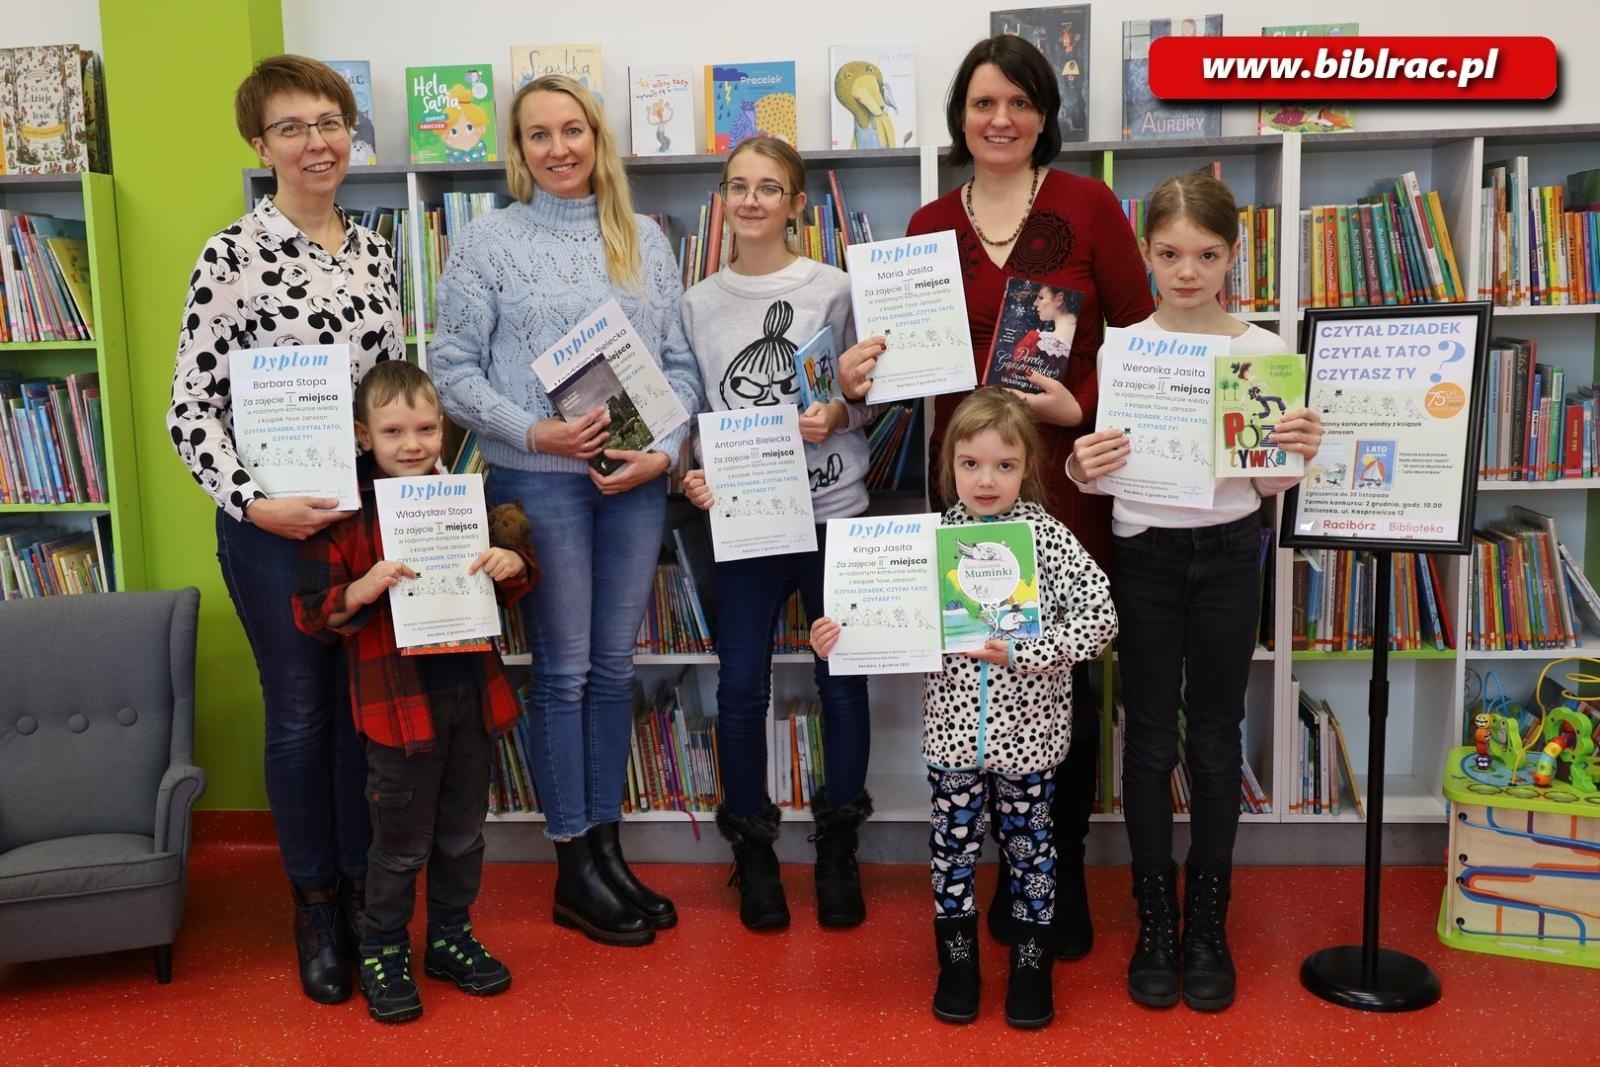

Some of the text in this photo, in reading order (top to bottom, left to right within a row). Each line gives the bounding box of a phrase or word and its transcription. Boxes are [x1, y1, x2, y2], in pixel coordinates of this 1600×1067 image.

[523, 50, 593, 80] Szpilka
[414, 72, 450, 97] Hela
[740, 75, 783, 85] Precelek
[423, 94, 461, 114] sama
[870, 242, 938, 263] Dyplom
[877, 265, 934, 280] Maria Jasita
[864, 288, 873, 297] Za
[876, 286, 902, 296] zajęcie
[915, 278, 950, 289] miejsca
[1321, 322, 1460, 338] CZYTAŁ DZIADEK
[553, 316, 608, 366] Dyplom
[1128, 337, 1208, 358] Dyplom
[1013, 347, 1044, 365] Dorota
[1318, 345, 1431, 359] CZYTAŁ TATO
[252, 352, 328, 372] Dyplom
[1122, 362, 1206, 377] Weronika Jasita
[1516, 350, 1527, 375] 365
[1316, 367, 1416, 381] CZYTASZ TY
[253, 377, 327, 389] Barbara Stopa
[1112, 379, 1123, 387] Za
[1124, 381, 1155, 391] zajęcie
[1170, 384, 1211, 395] miejsca
[255, 396, 284, 406] zajęcie
[299, 393, 338, 404] miejsca
[1425, 391, 1446, 407] 75
[720, 414, 784, 432] Dyplom
[714, 435, 791, 450] Antonina Bielecka
[1366, 446, 1388, 454] LATO
[724, 455, 750, 464] zajęcie
[762, 449, 794, 459] miejsca
[400, 481, 467, 500] Dyplom
[396, 506, 473, 520] Władysław Stopa
[1351, 508, 1396, 517] Kasprowicza
[394, 528, 403, 536] Za
[406, 526, 433, 534] zajęcie
[446, 522, 478, 532] miejsca
[849, 521, 921, 539] Dyplom
[1323, 519, 1443, 533] Racibórz Biblioteka
[853, 543, 912, 555] Kinga Jasita
[848, 559, 876, 569] zajęcie
[890, 557, 928, 567] miejsca
[965, 567, 1012, 579] Muminki
